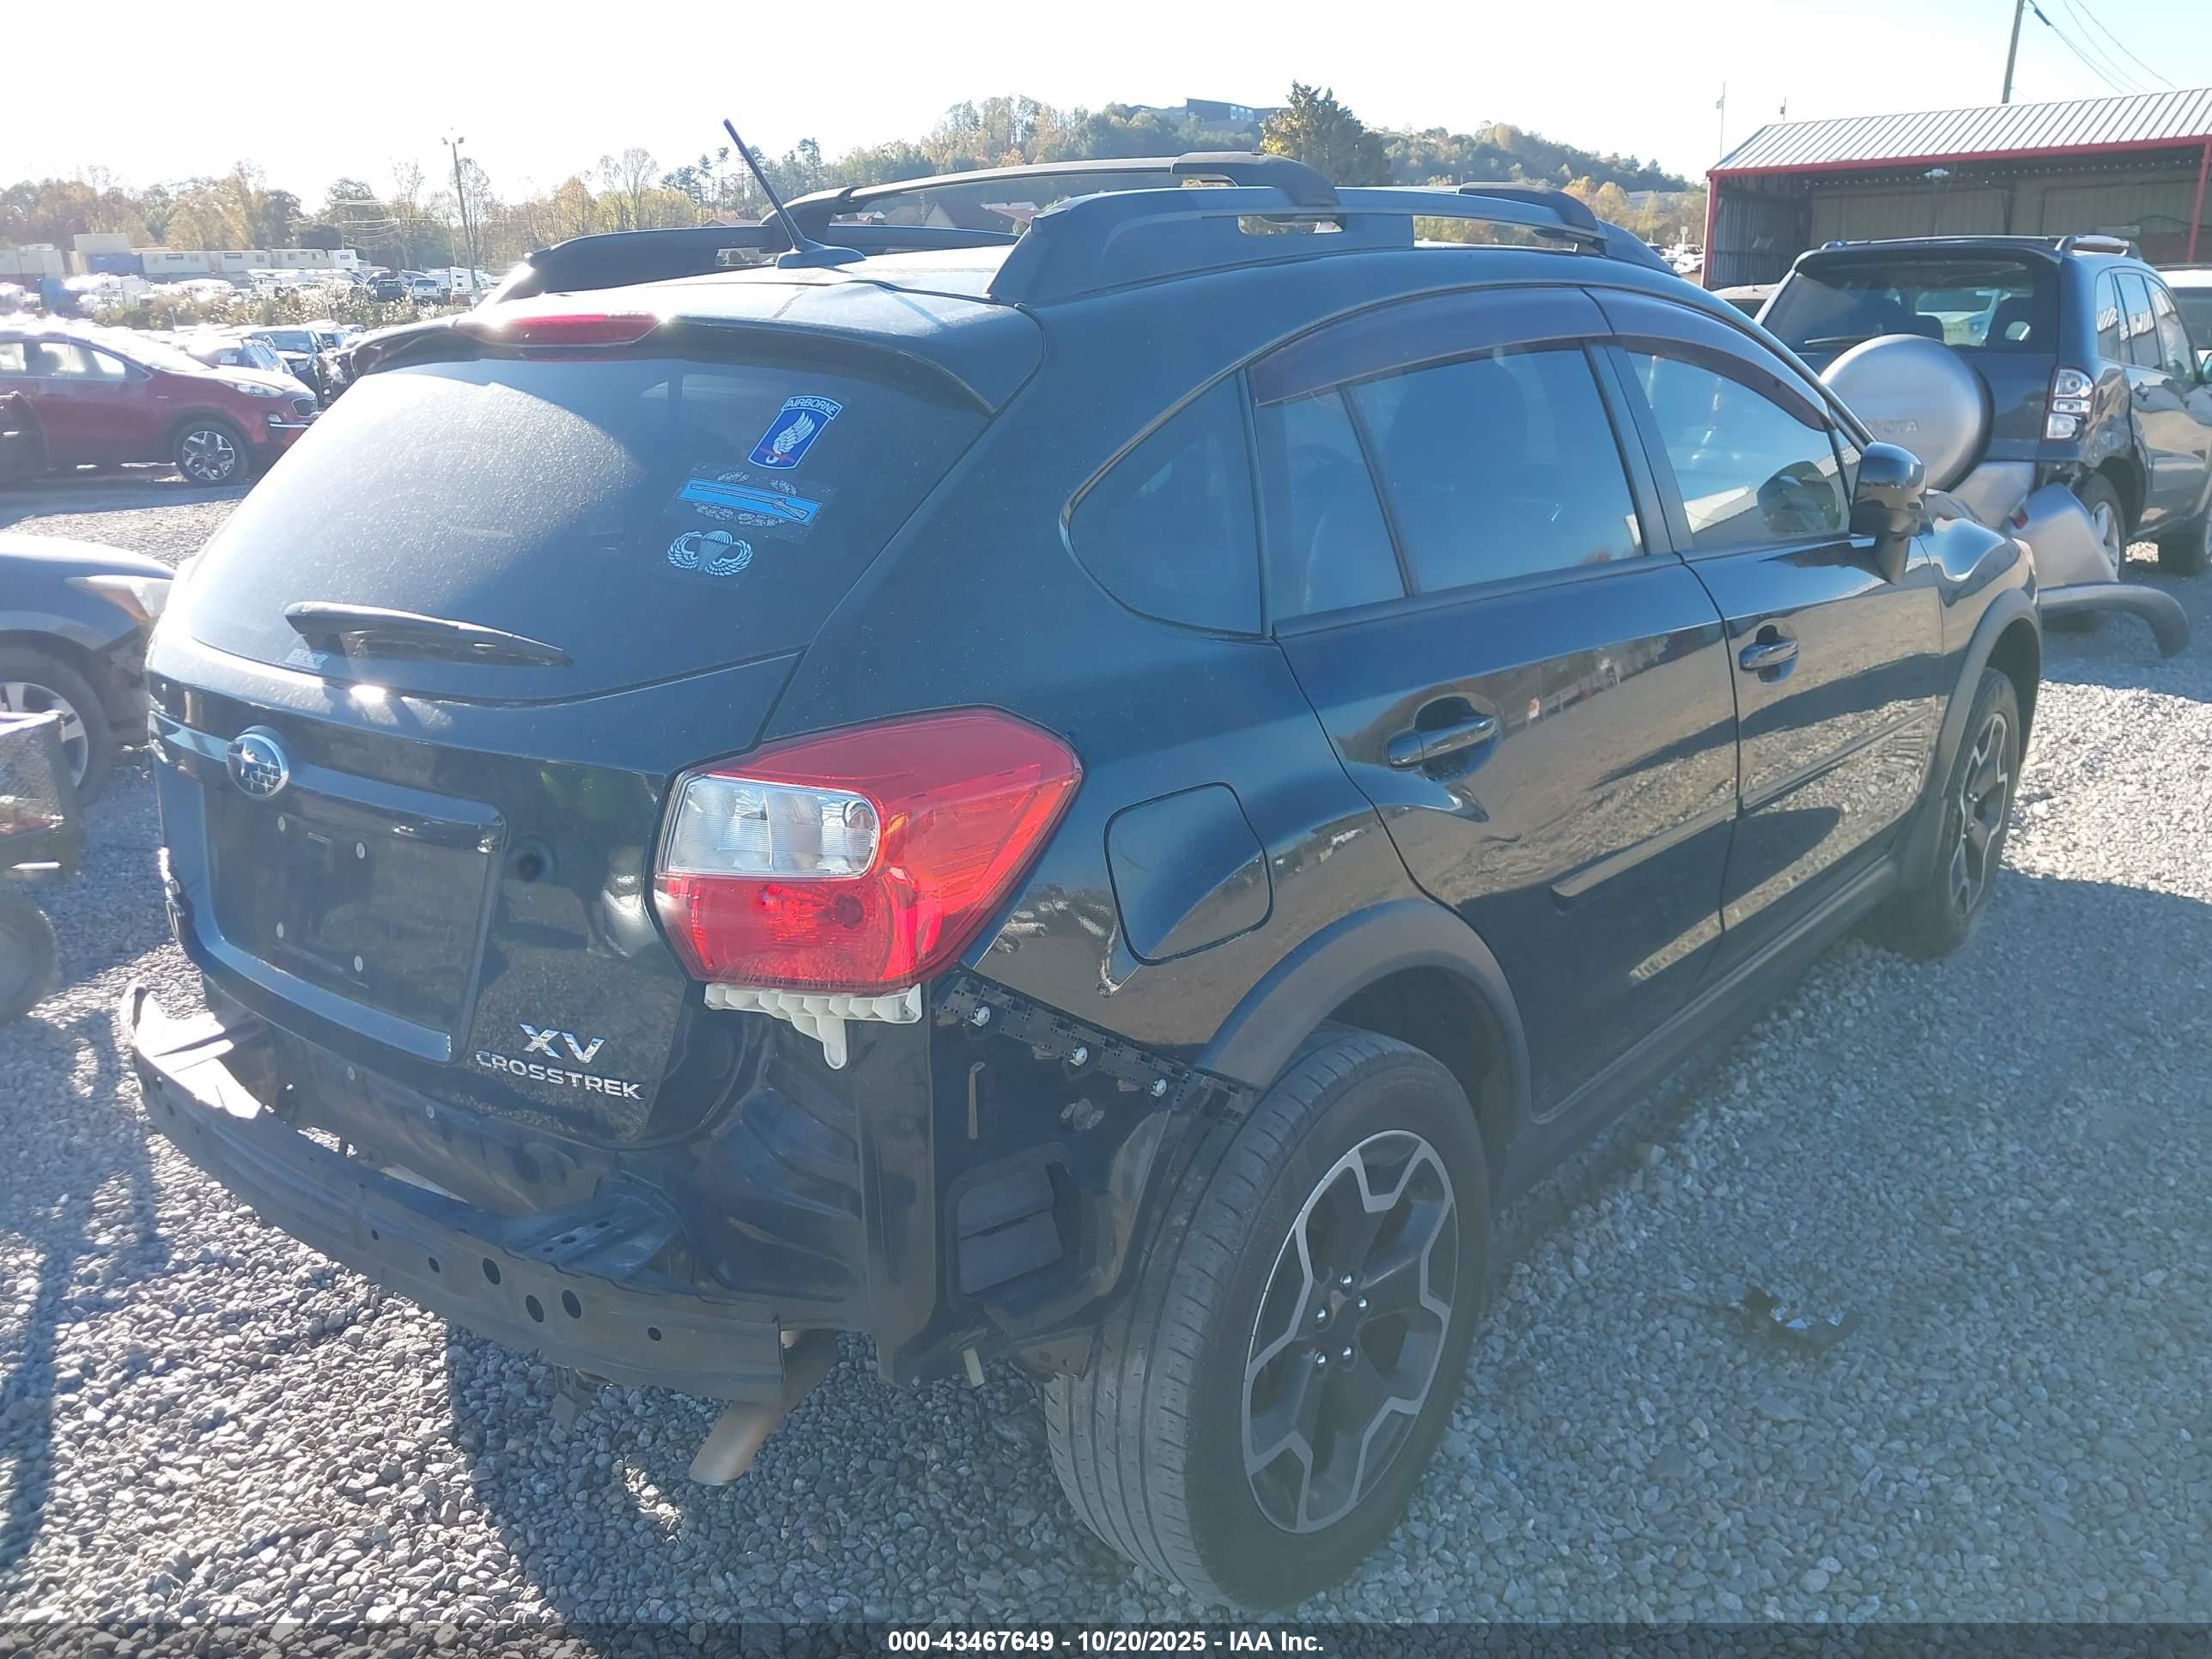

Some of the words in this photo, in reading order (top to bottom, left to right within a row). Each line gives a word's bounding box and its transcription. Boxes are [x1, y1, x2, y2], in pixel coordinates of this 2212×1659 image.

[787, 398, 839, 416] AIRBORNE
[519, 1023, 605, 1065] XV
[474, 1050, 645, 1101] CROSSTREK
